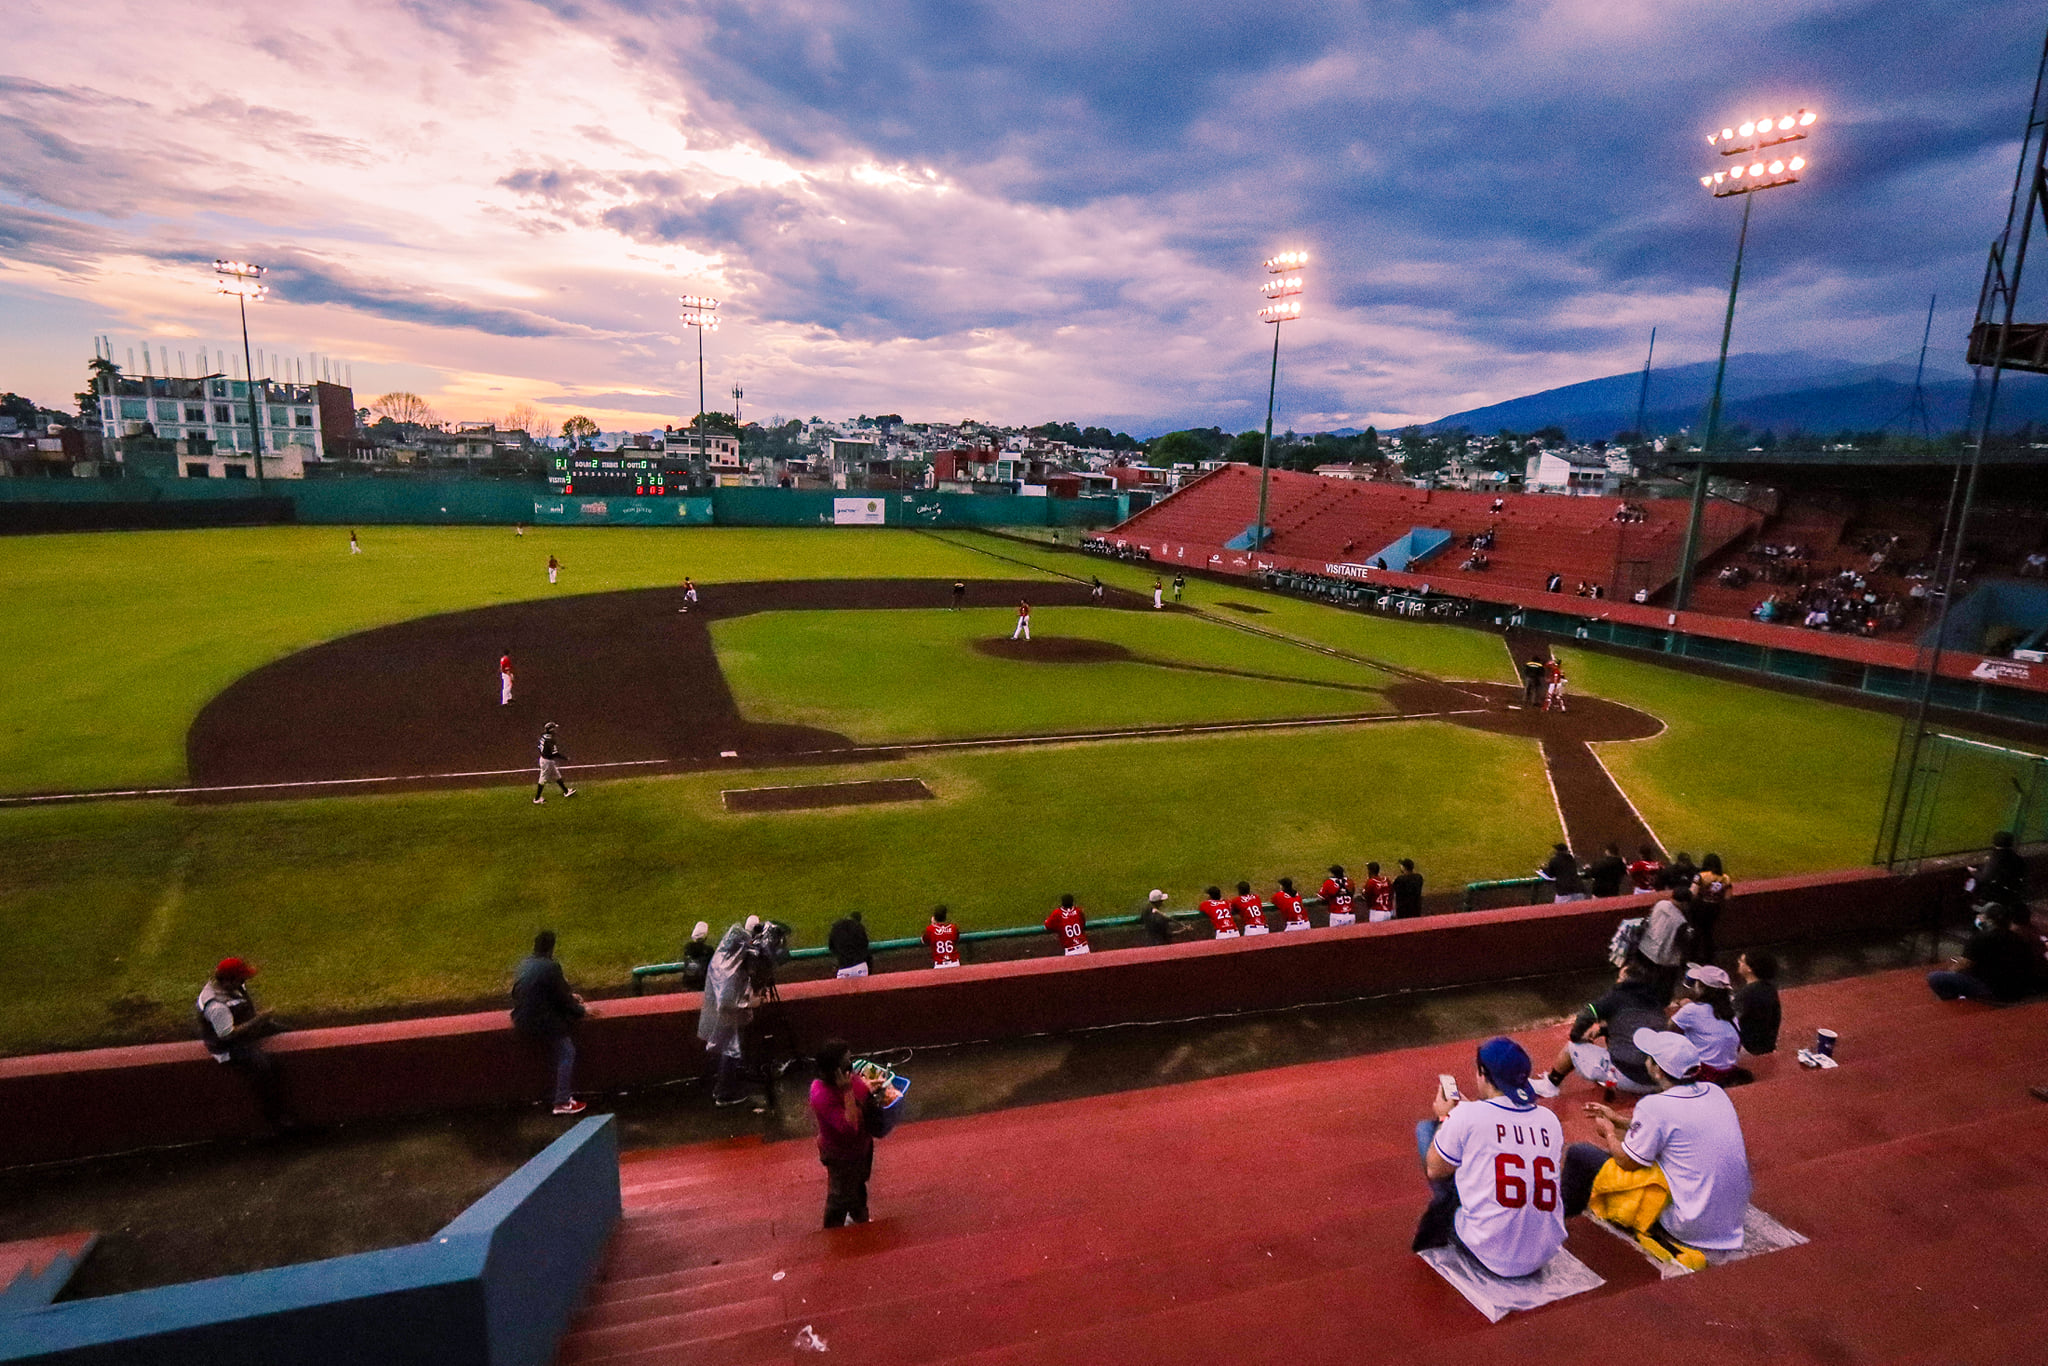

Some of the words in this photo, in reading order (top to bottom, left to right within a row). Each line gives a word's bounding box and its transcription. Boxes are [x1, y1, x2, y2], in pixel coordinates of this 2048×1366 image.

[592, 459, 598, 468] 2
[641, 460, 647, 469] 0
[636, 477, 642, 485] 3
[650, 477, 656, 485] 2
[658, 477, 663, 485] 0
[566, 485, 573, 494] 0
[658, 486, 665, 495] 3
[1326, 563, 1368, 578] VISITANTE
[1376, 893, 1390, 905] 47
[1215, 908, 1232, 919] 22
[1247, 905, 1262, 918] 18
[1293, 901, 1302, 914] 6
[1065, 923, 1081, 938] 60
[936, 940, 954, 953] 86
[1496, 1124, 1550, 1147] PUIG
[1495, 1153, 1557, 1212] 66
